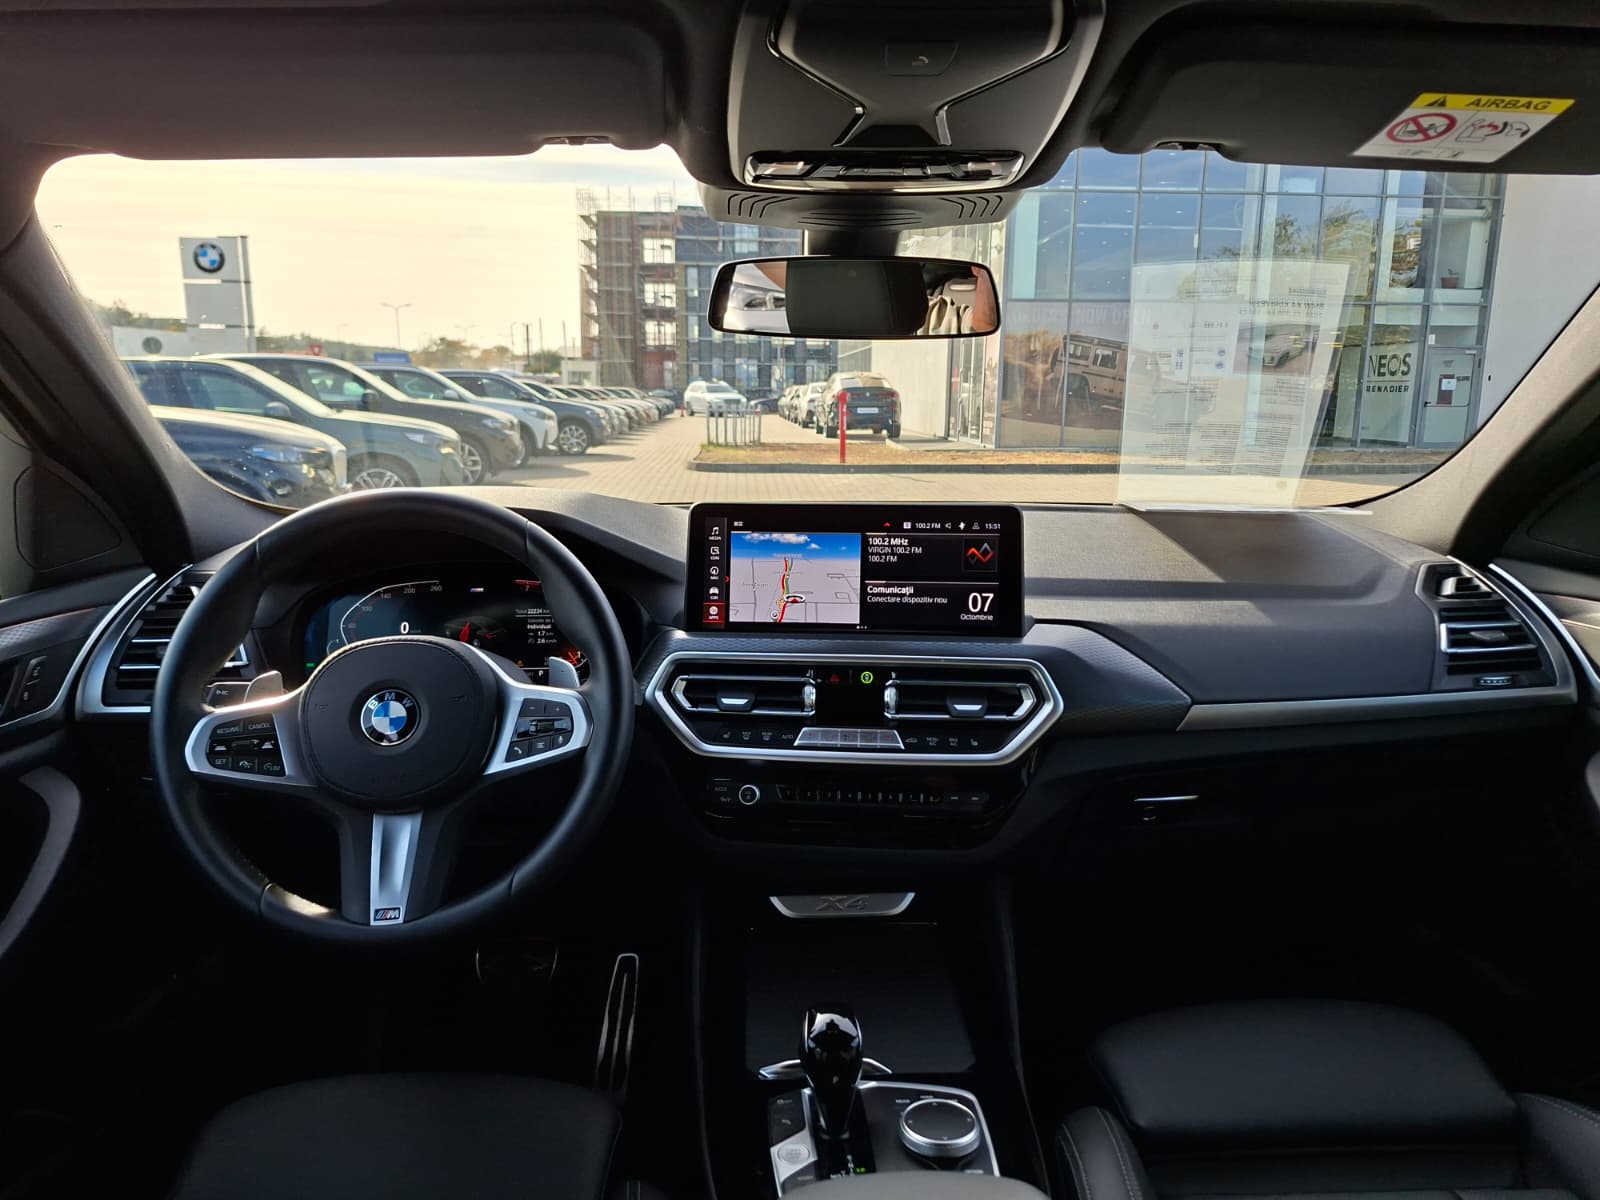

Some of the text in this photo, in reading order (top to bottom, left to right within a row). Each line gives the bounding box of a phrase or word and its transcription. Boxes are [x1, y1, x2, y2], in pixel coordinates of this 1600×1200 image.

[1465, 98, 1551, 110] AIRBAG
[867, 595, 901, 603] Conectare
[902, 596, 933, 604] dispozitiv
[968, 592, 994, 613] 07
[960, 613, 994, 621] Octombrie
[400, 621, 410, 634] 0
[368, 692, 413, 709] BMW
[816, 896, 869, 911] X4
